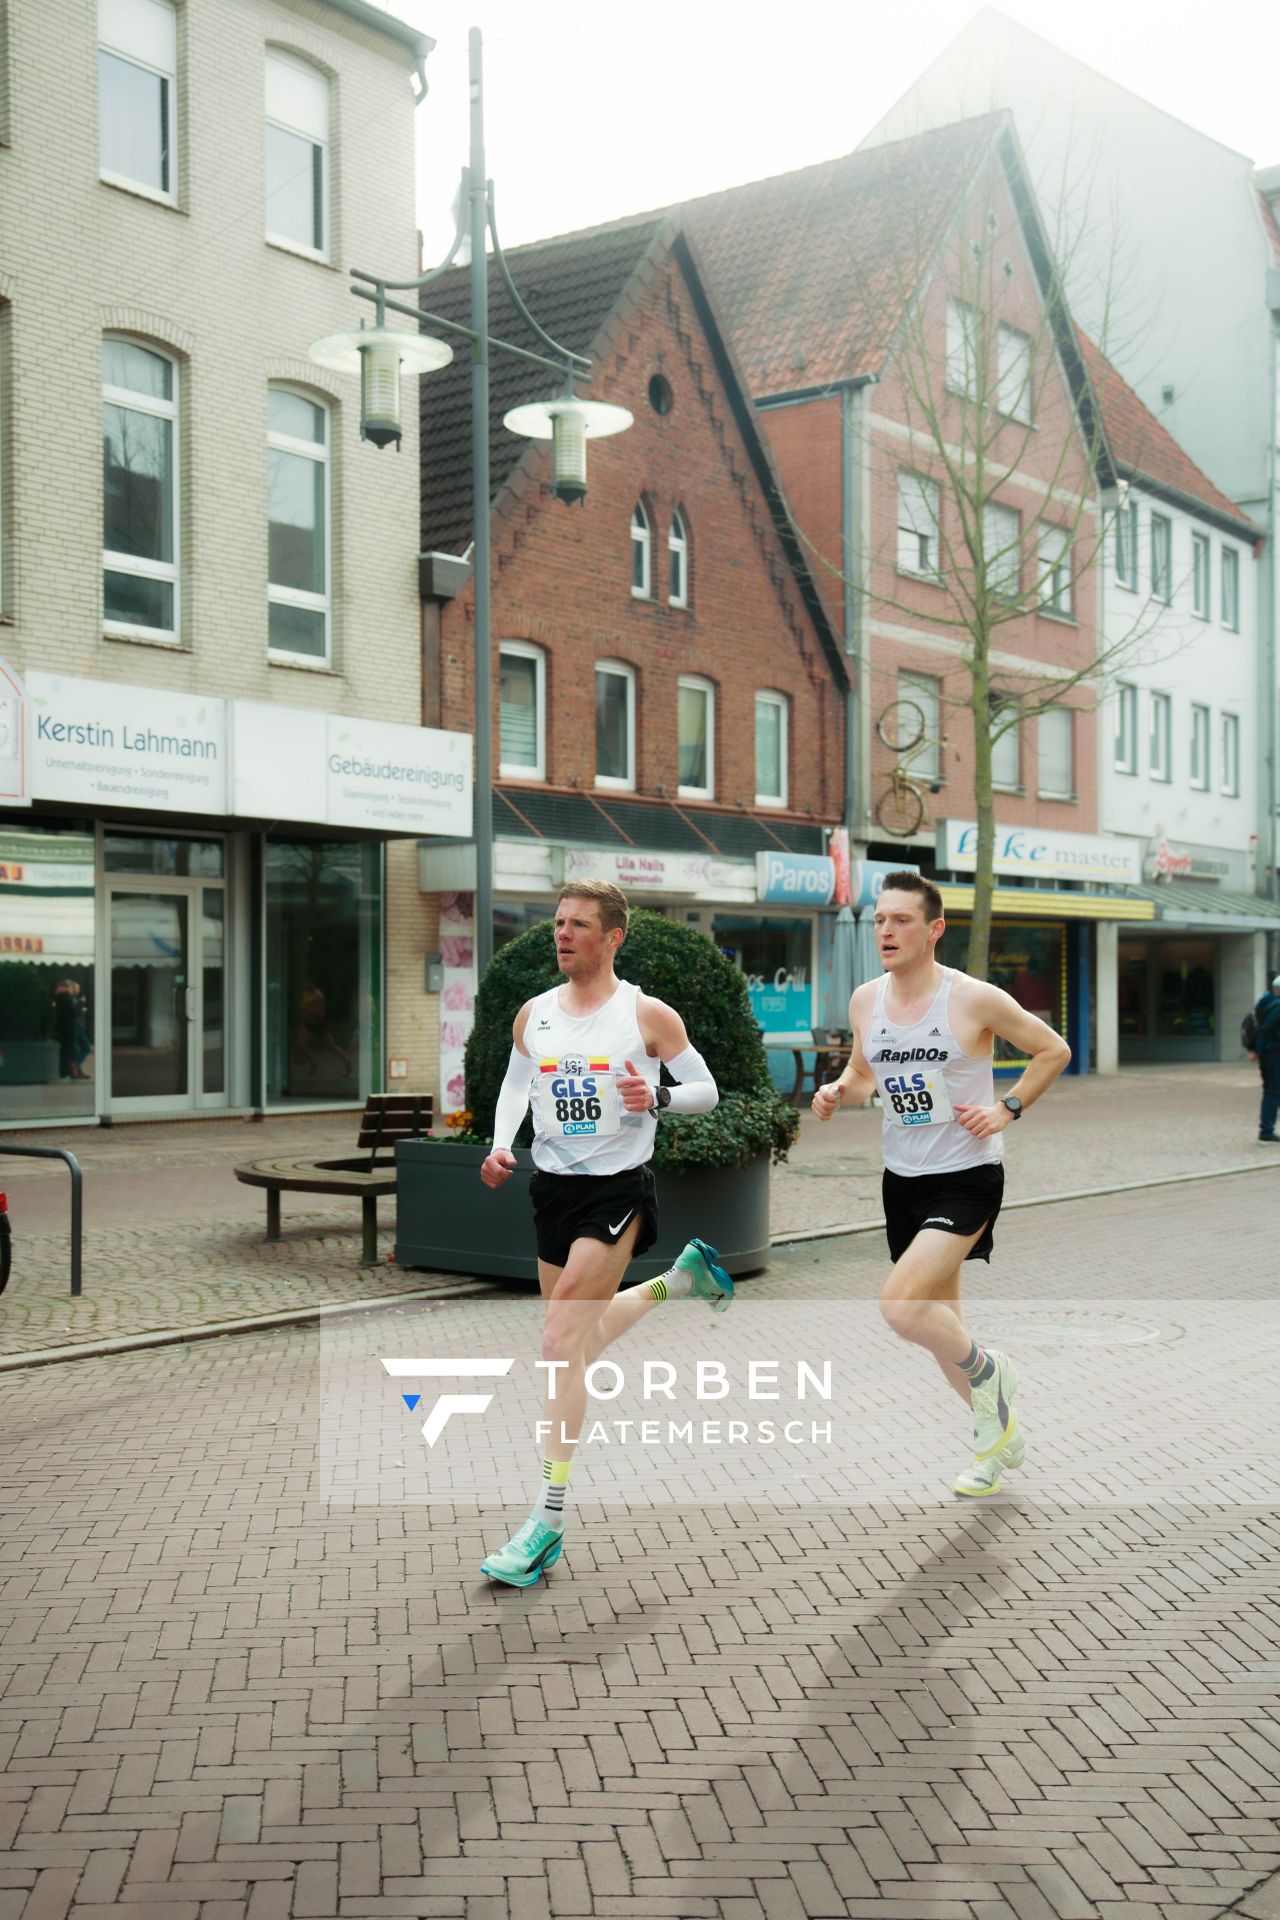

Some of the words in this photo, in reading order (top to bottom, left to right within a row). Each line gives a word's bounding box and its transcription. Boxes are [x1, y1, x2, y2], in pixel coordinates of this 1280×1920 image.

[38, 714, 114, 748] Kerstin
[123, 726, 217, 759] Lahmann
[329, 754, 464, 792] Gebäudereinigung
[957, 827, 1047, 861] bke
[1055, 850, 1131, 868] master
[770, 861, 829, 893] Paros
[880, 1048, 949, 1064] RapiDOs
[556, 1097, 602, 1122] 886
[891, 1091, 934, 1114] 839
